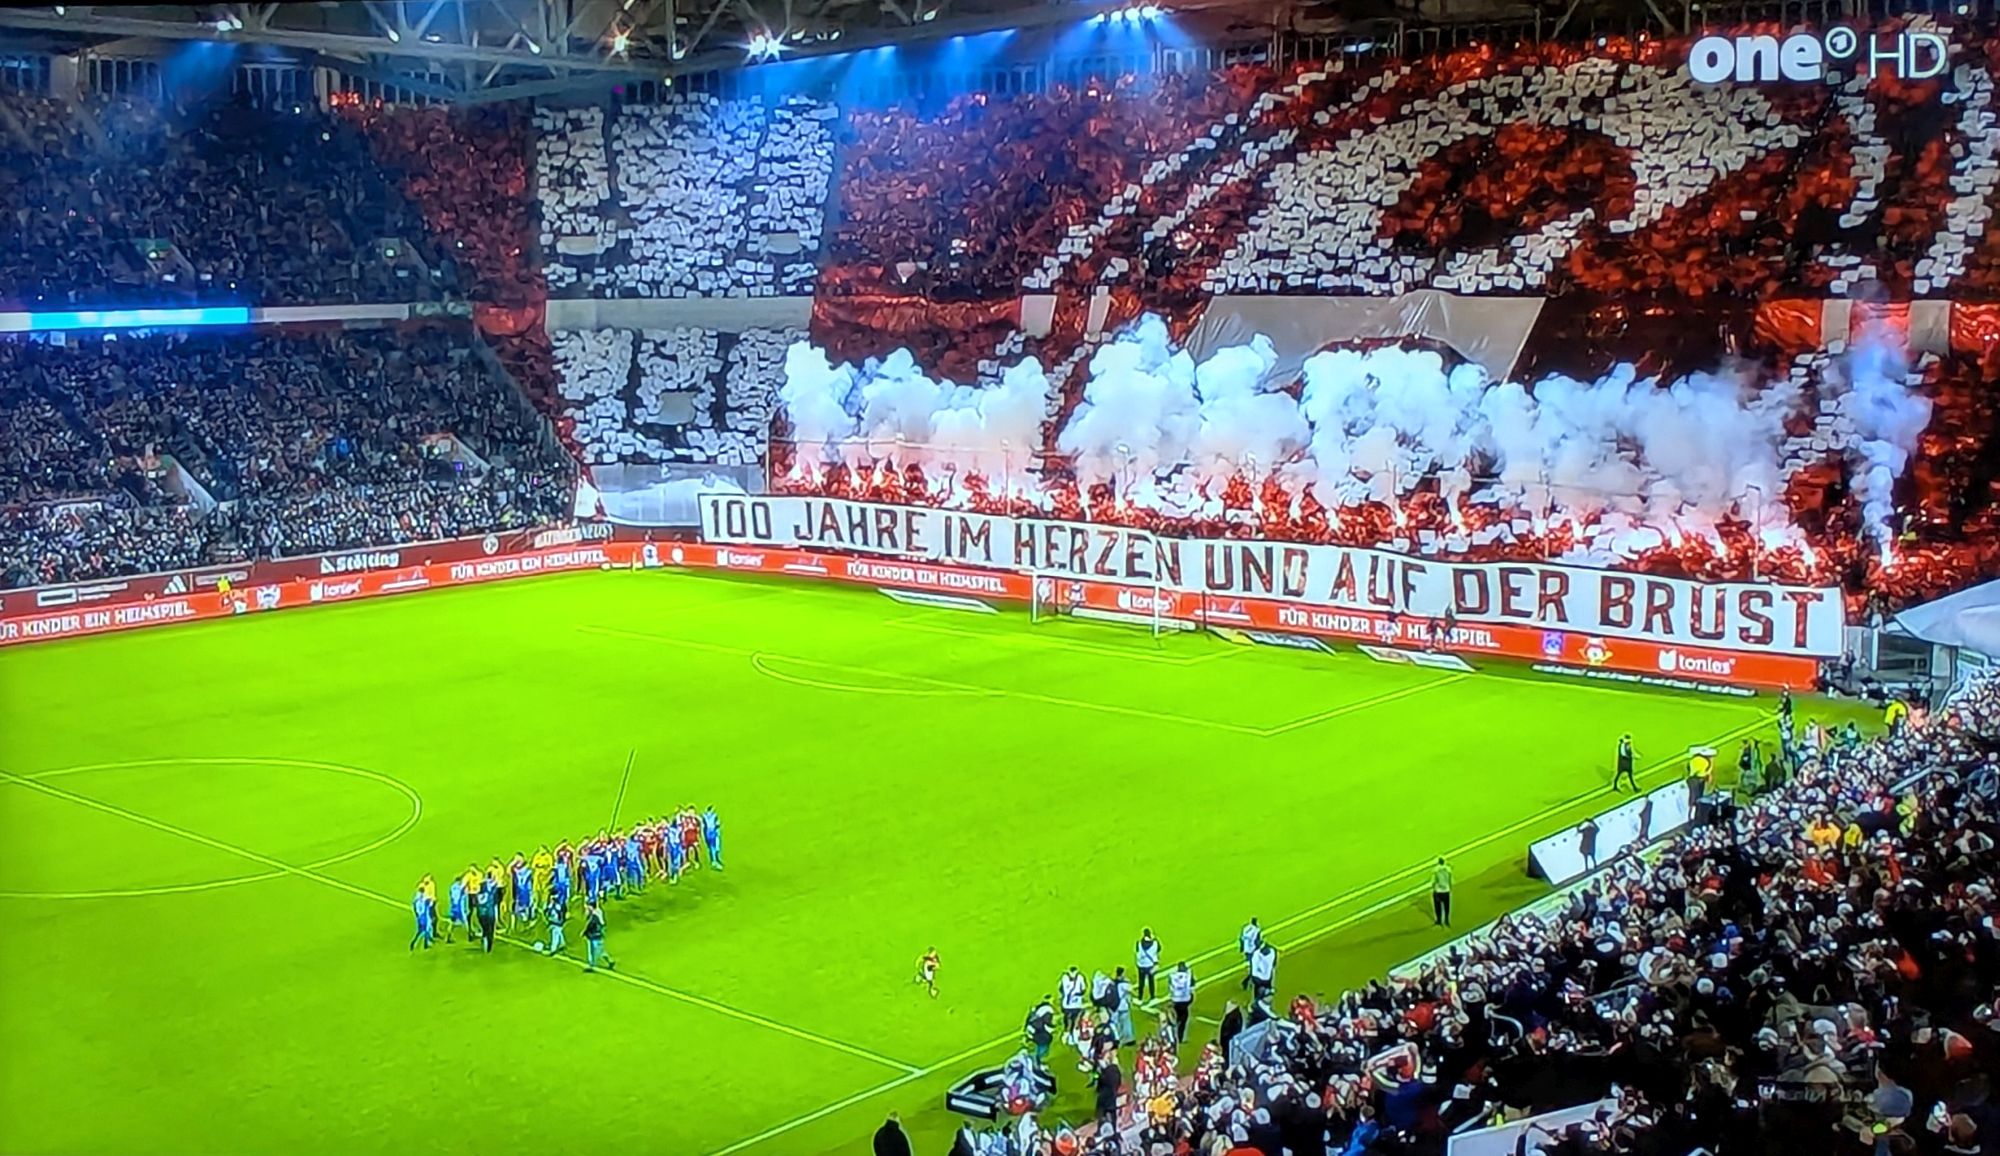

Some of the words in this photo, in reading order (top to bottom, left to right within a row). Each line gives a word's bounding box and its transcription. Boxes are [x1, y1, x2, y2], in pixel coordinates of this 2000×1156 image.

[336, 552, 399, 572] Stölting
[451, 563, 475, 580] FÜR
[476, 561, 520, 577] KINDER
[710, 499, 772, 540] 100
[793, 500, 929, 553] JAHRE
[945, 515, 992, 562] IM
[1014, 522, 1183, 586] HERZEN
[1204, 544, 1309, 598] UND
[1329, 552, 1428, 611] AUF
[1452, 567, 1570, 623] DER
[1599, 576, 1824, 649] BRUST
[871, 565, 915, 583] KINDER
[916, 569, 939, 585] EIN
[1131, 594, 1173, 612] tones
[0, 618, 18, 640] ÜR
[23, 615, 81, 637] KINDER
[84, 610, 110, 629] EIN
[1279, 607, 1308, 627] FÜR
[1312, 610, 1371, 634] KINDER
[1407, 623, 1501, 648] HESPIEL.
